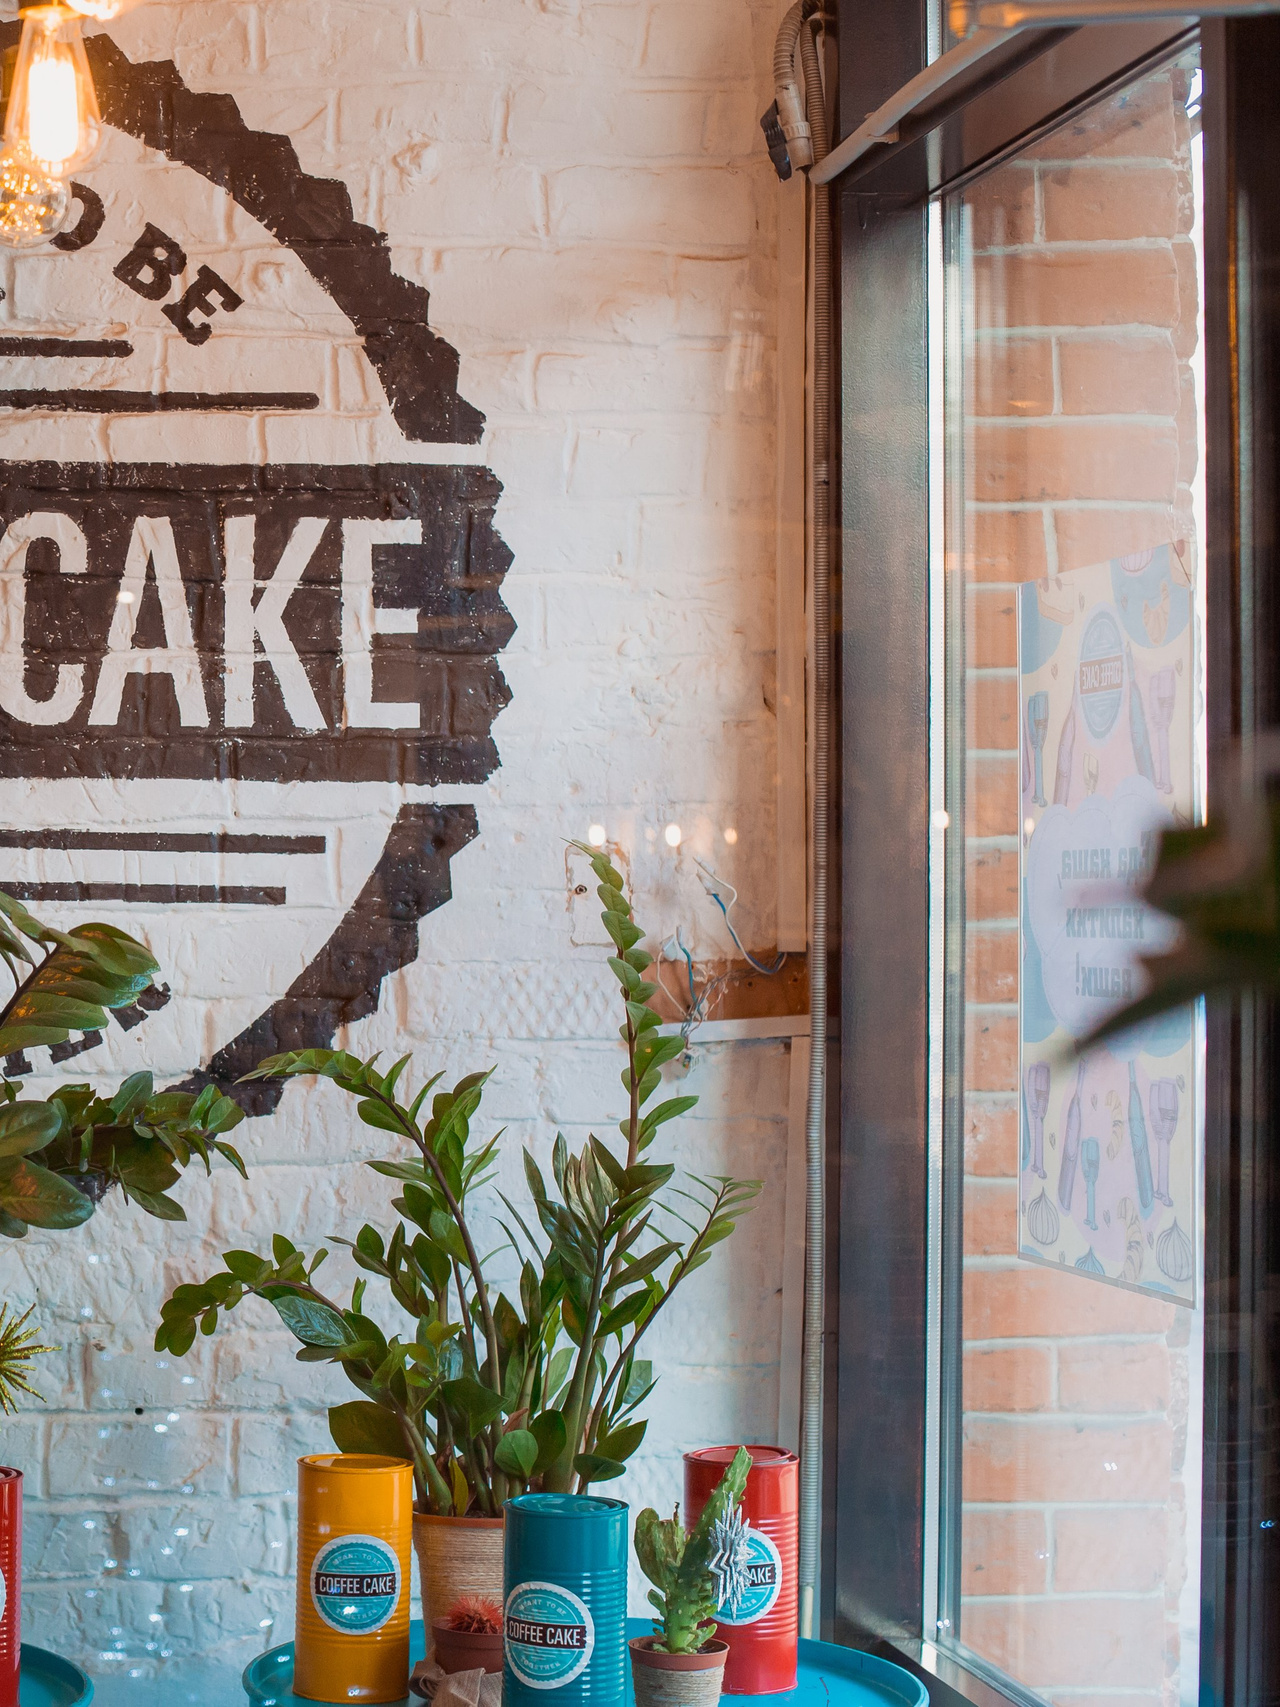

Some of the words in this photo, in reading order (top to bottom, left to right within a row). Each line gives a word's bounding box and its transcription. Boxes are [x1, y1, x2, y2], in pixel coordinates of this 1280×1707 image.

[112, 222, 245, 345] BE
[319, 1576, 360, 1594] COFFEE
[364, 1576, 393, 1594] CAKE
[509, 1620, 544, 1644] COFFEE
[546, 1627, 581, 1646] CAKE
